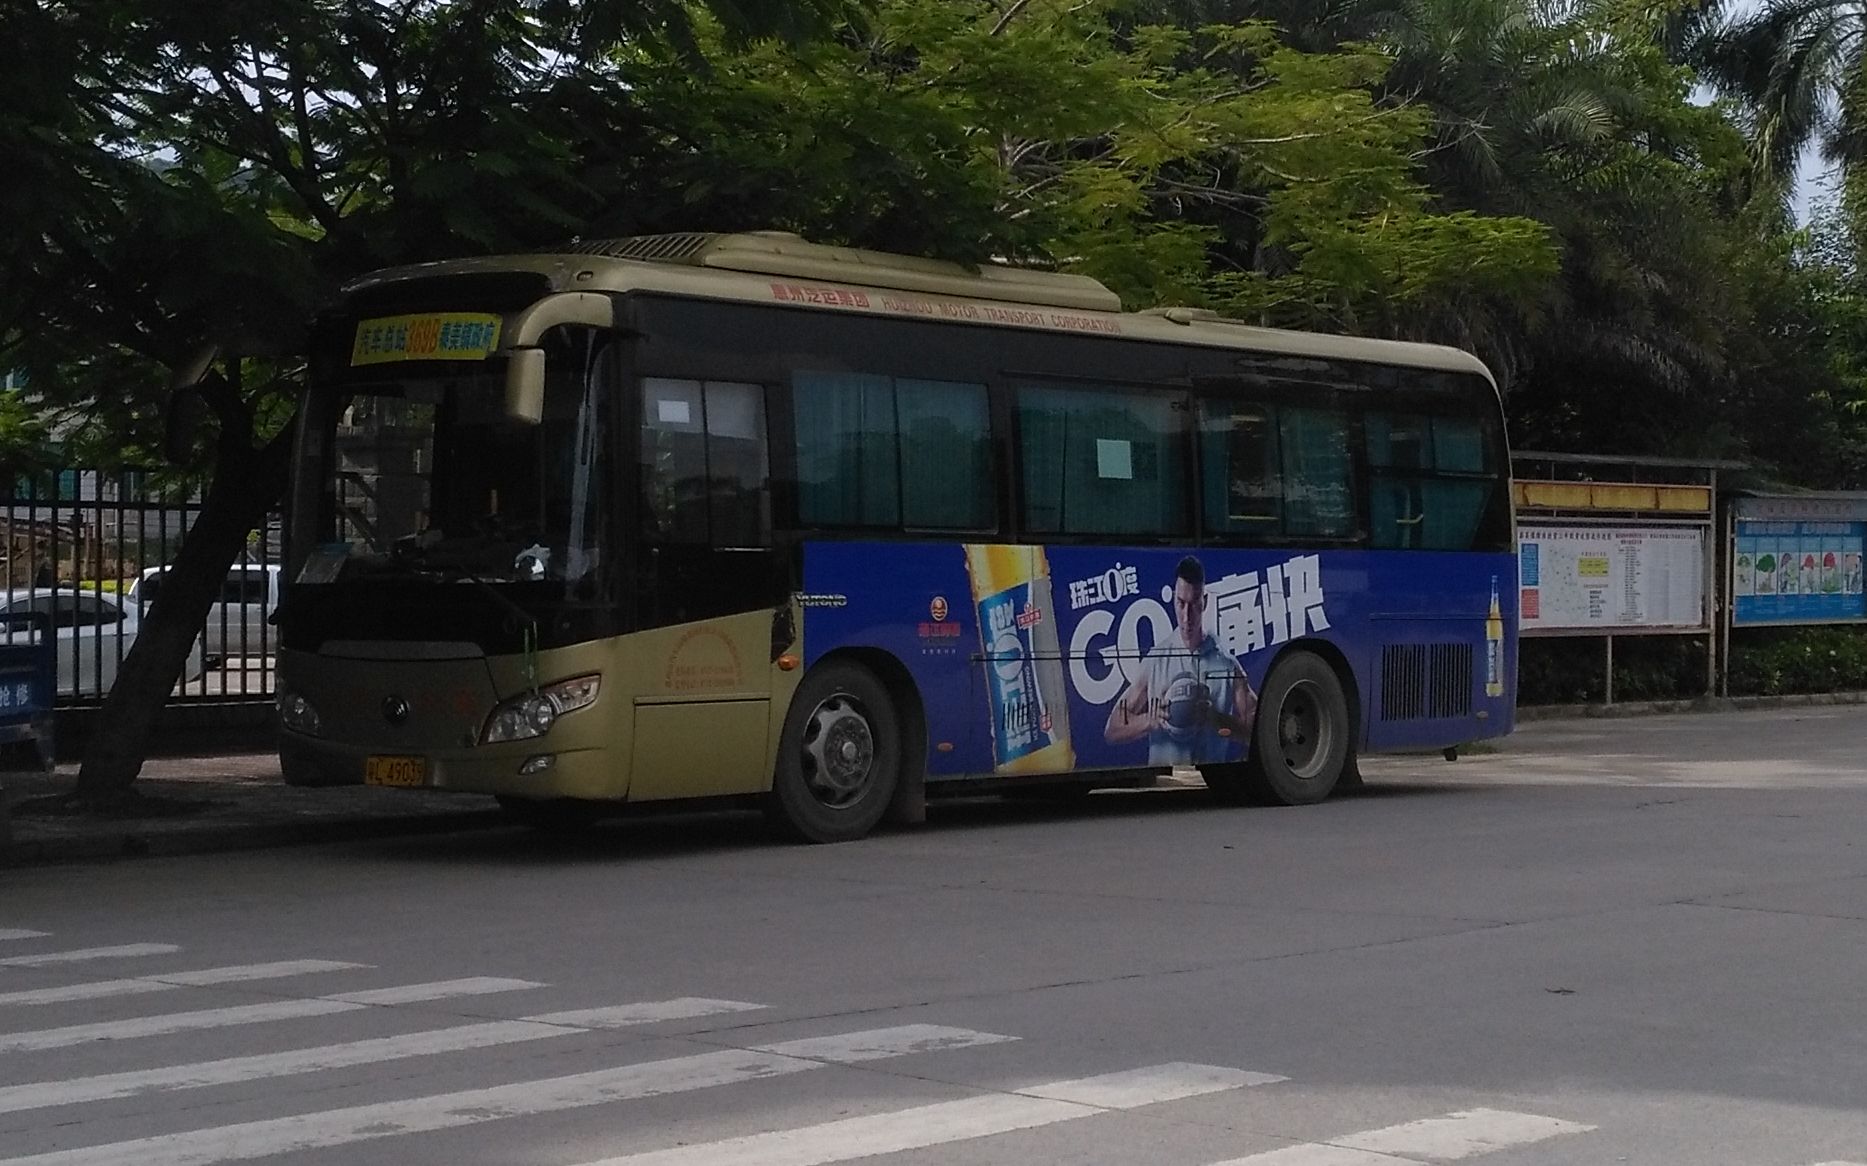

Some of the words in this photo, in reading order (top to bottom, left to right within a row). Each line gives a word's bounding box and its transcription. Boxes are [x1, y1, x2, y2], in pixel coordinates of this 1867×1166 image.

[882, 297, 932, 314] HUIZHOU
[939, 303, 980, 319] MOTOR
[984, 308, 1046, 326] TRANSPORT
[1051, 314, 1121, 334] CORPORATION
